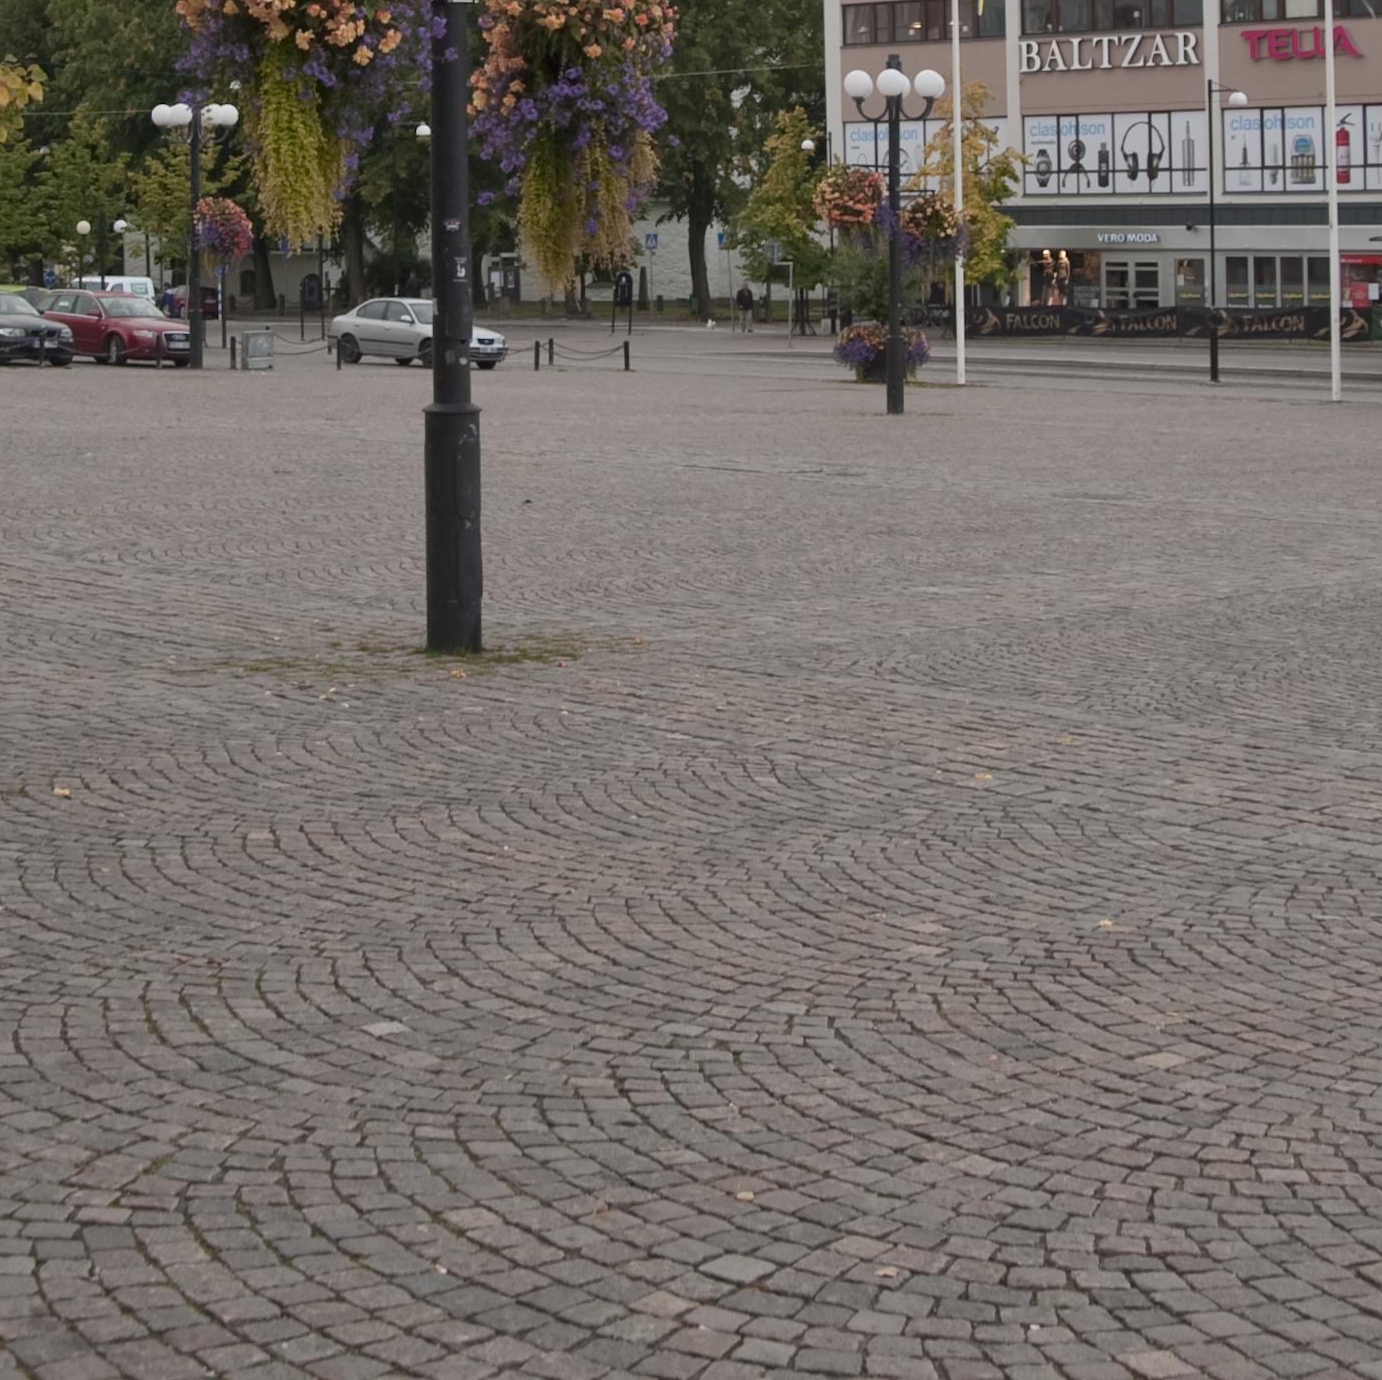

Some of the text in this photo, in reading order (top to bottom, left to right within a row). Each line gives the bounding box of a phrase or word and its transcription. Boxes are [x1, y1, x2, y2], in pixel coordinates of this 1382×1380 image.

[1019, 31, 1200, 73] BALTZAR
[1061, 121, 1106, 136] ohson
[1096, 233, 1159, 243] VERO MODA
[1005, 313, 1305, 332] FALCON FALCON FALCON
